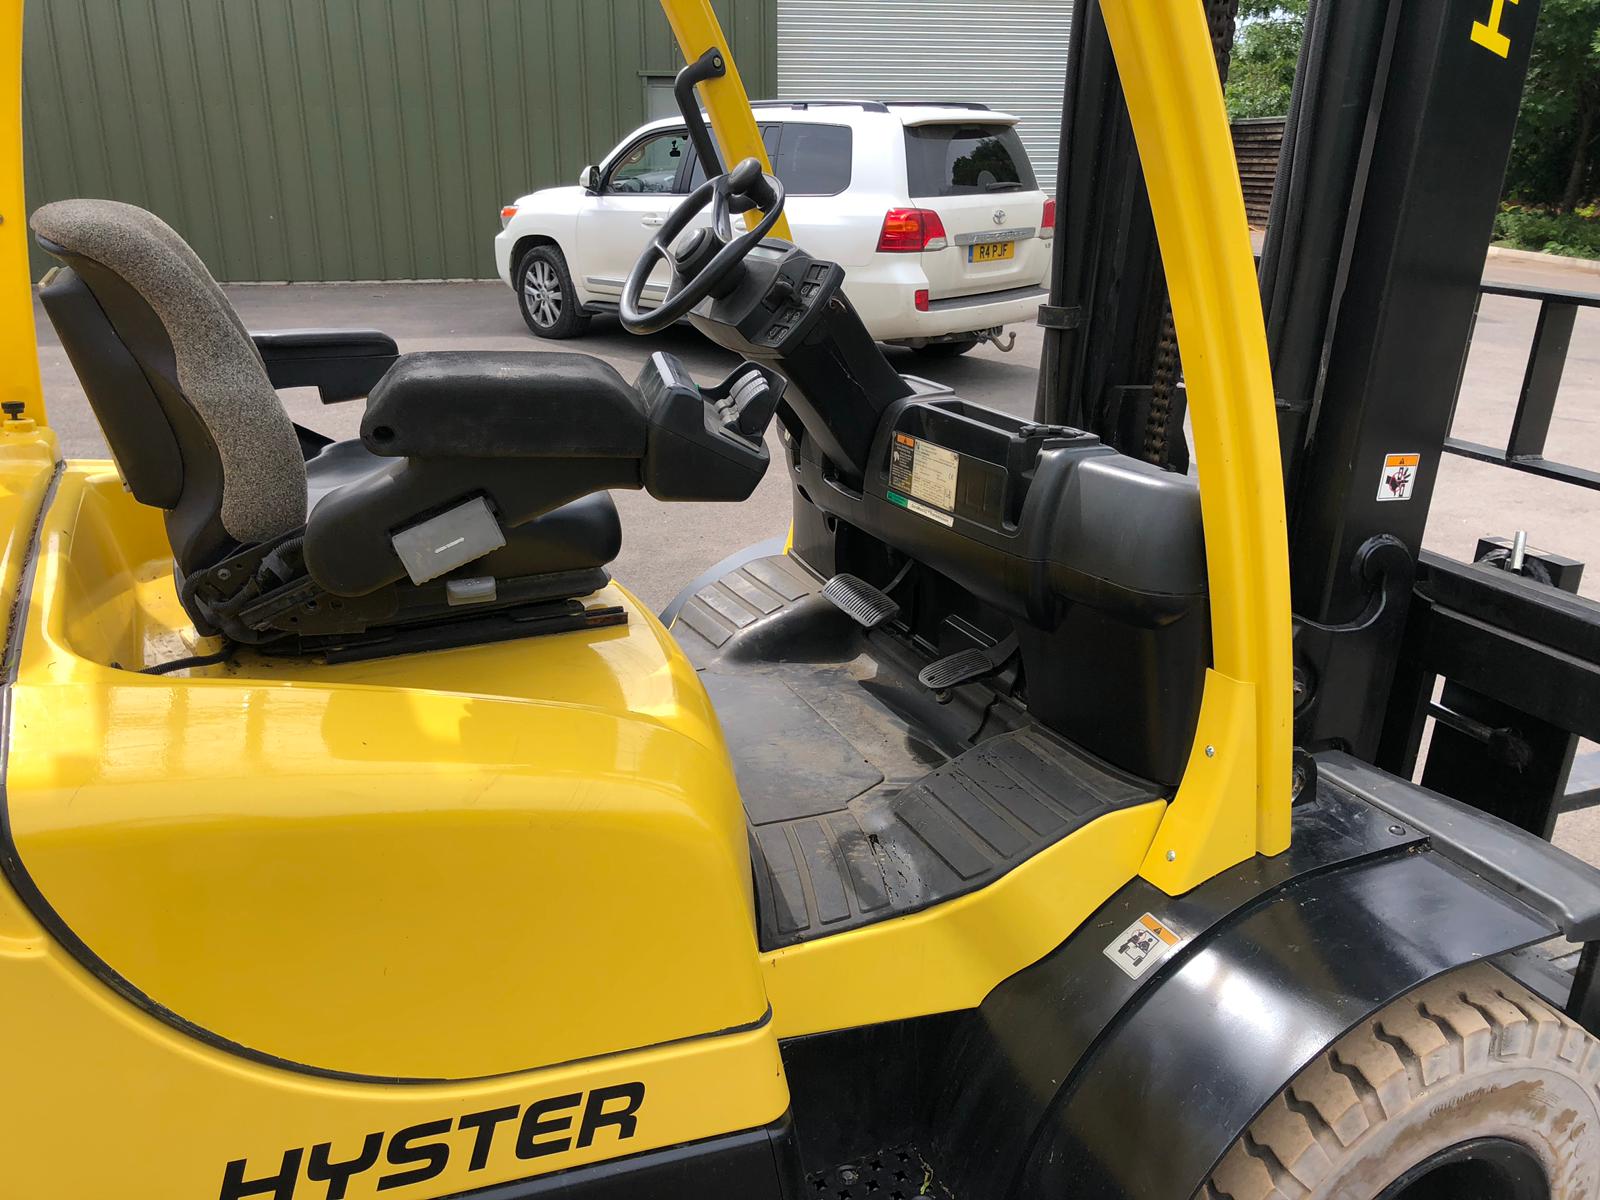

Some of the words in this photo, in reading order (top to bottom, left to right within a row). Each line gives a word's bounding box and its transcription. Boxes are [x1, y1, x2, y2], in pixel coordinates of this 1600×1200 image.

[979, 245, 990, 260] R4
[992, 243, 1008, 258] PJF
[219, 1081, 646, 1200] HYSTER
